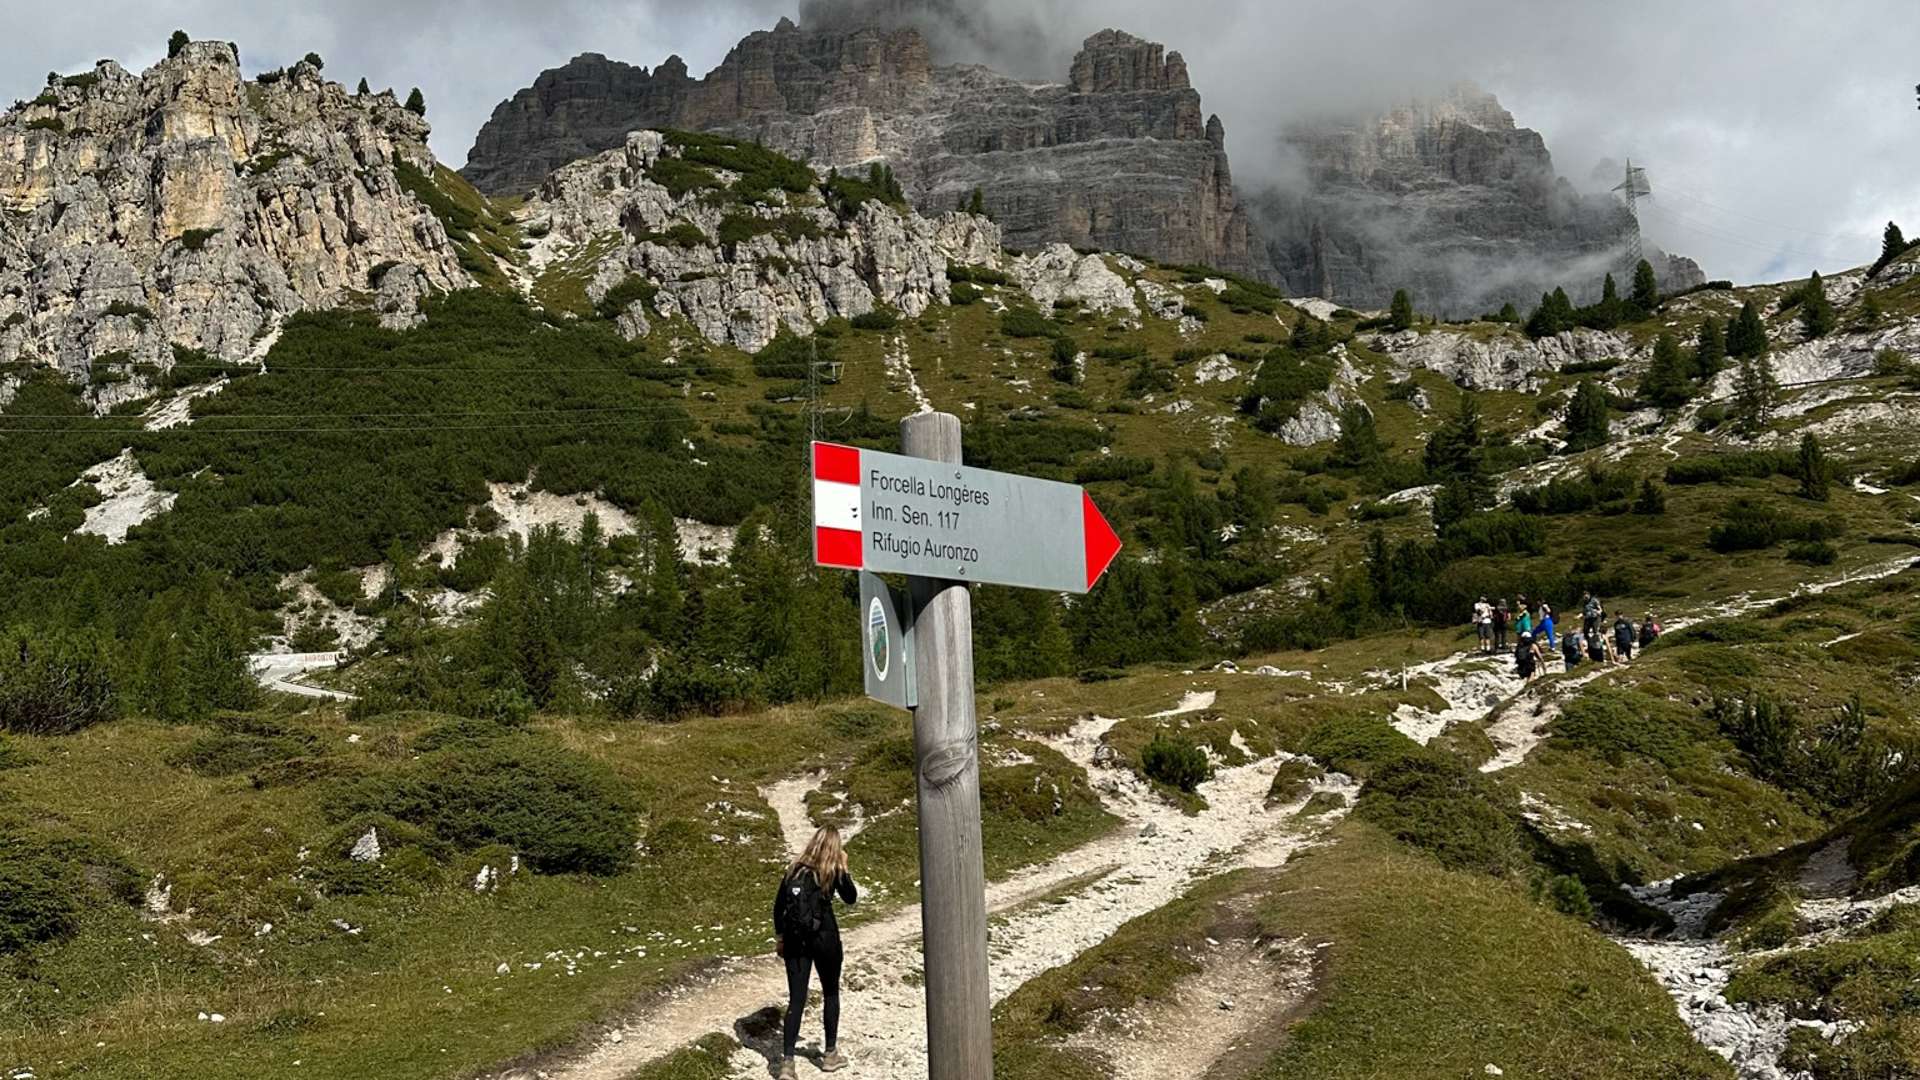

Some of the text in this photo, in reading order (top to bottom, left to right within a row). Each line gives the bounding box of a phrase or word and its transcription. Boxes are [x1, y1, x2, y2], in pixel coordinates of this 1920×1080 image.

[870, 470, 990, 506] Forcella Longères
[871, 501, 960, 530] Inn. Sen. 117
[872, 531, 979, 563] Rifugio Auronzo
